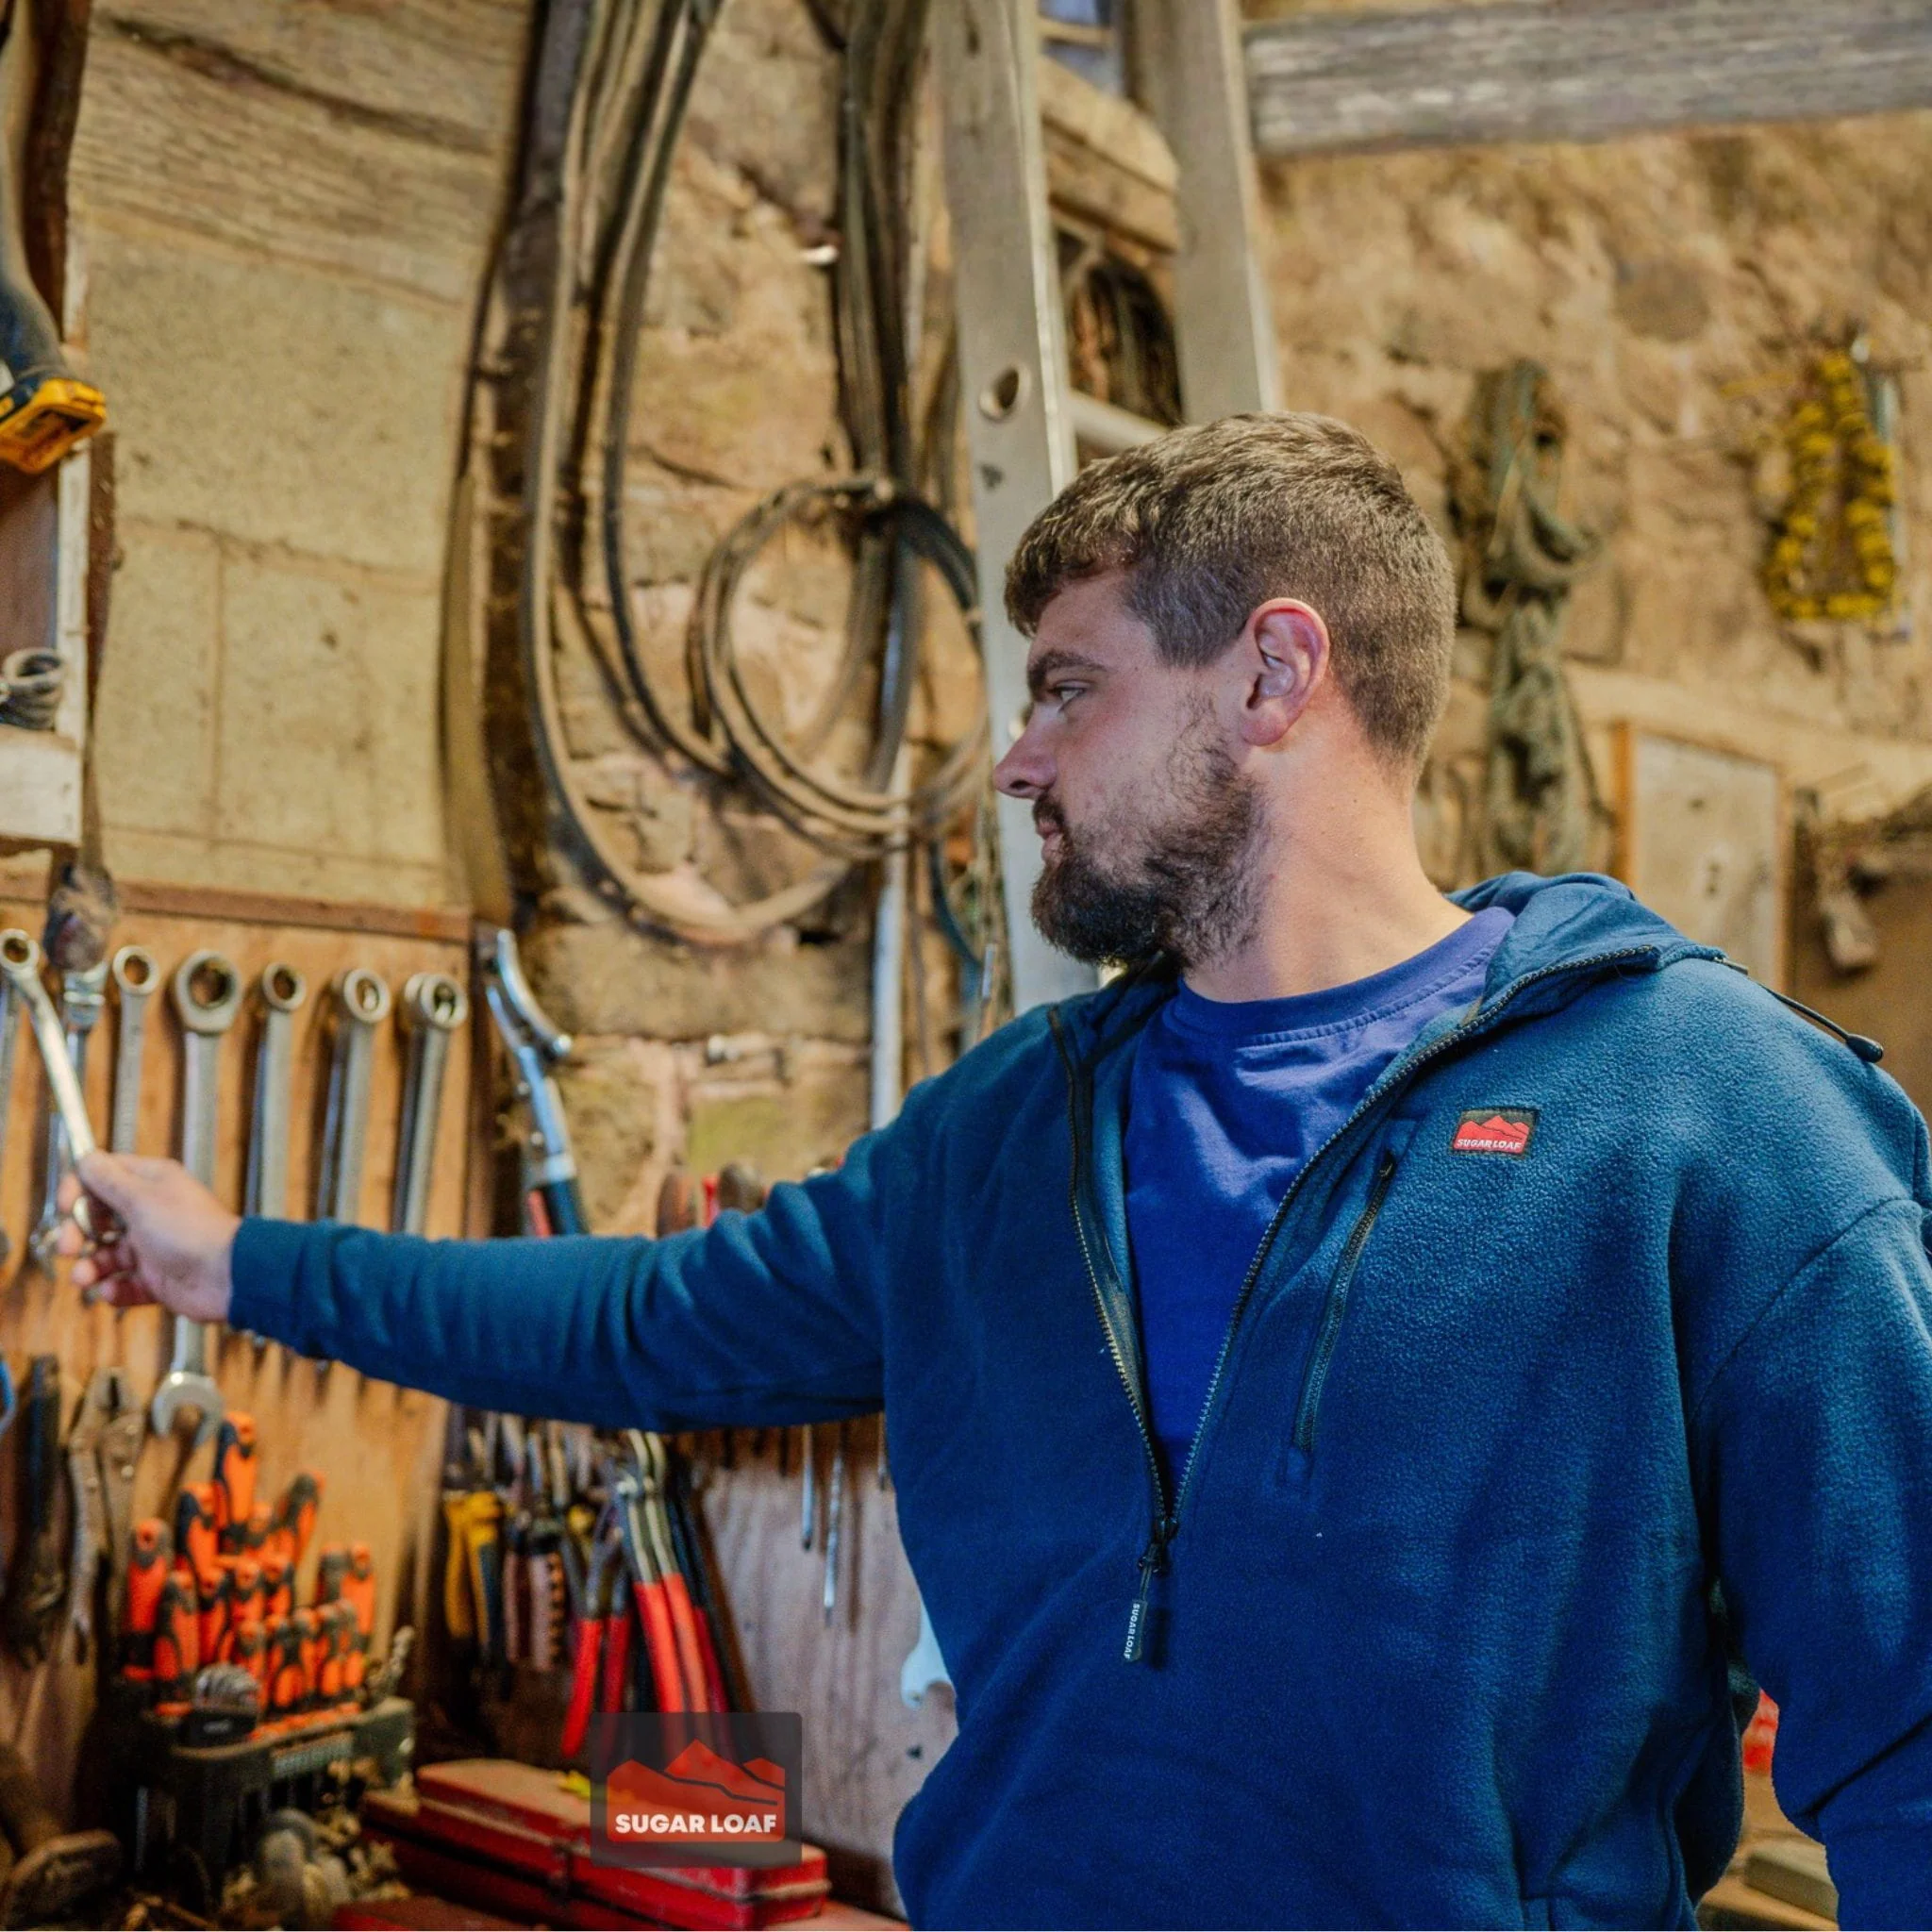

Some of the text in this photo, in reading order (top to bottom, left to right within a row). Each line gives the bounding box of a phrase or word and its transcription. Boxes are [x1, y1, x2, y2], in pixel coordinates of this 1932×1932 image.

[1457, 1139, 1522, 1149] SUGAR LOAF
[1124, 1635, 1134, 1659] LOAF
